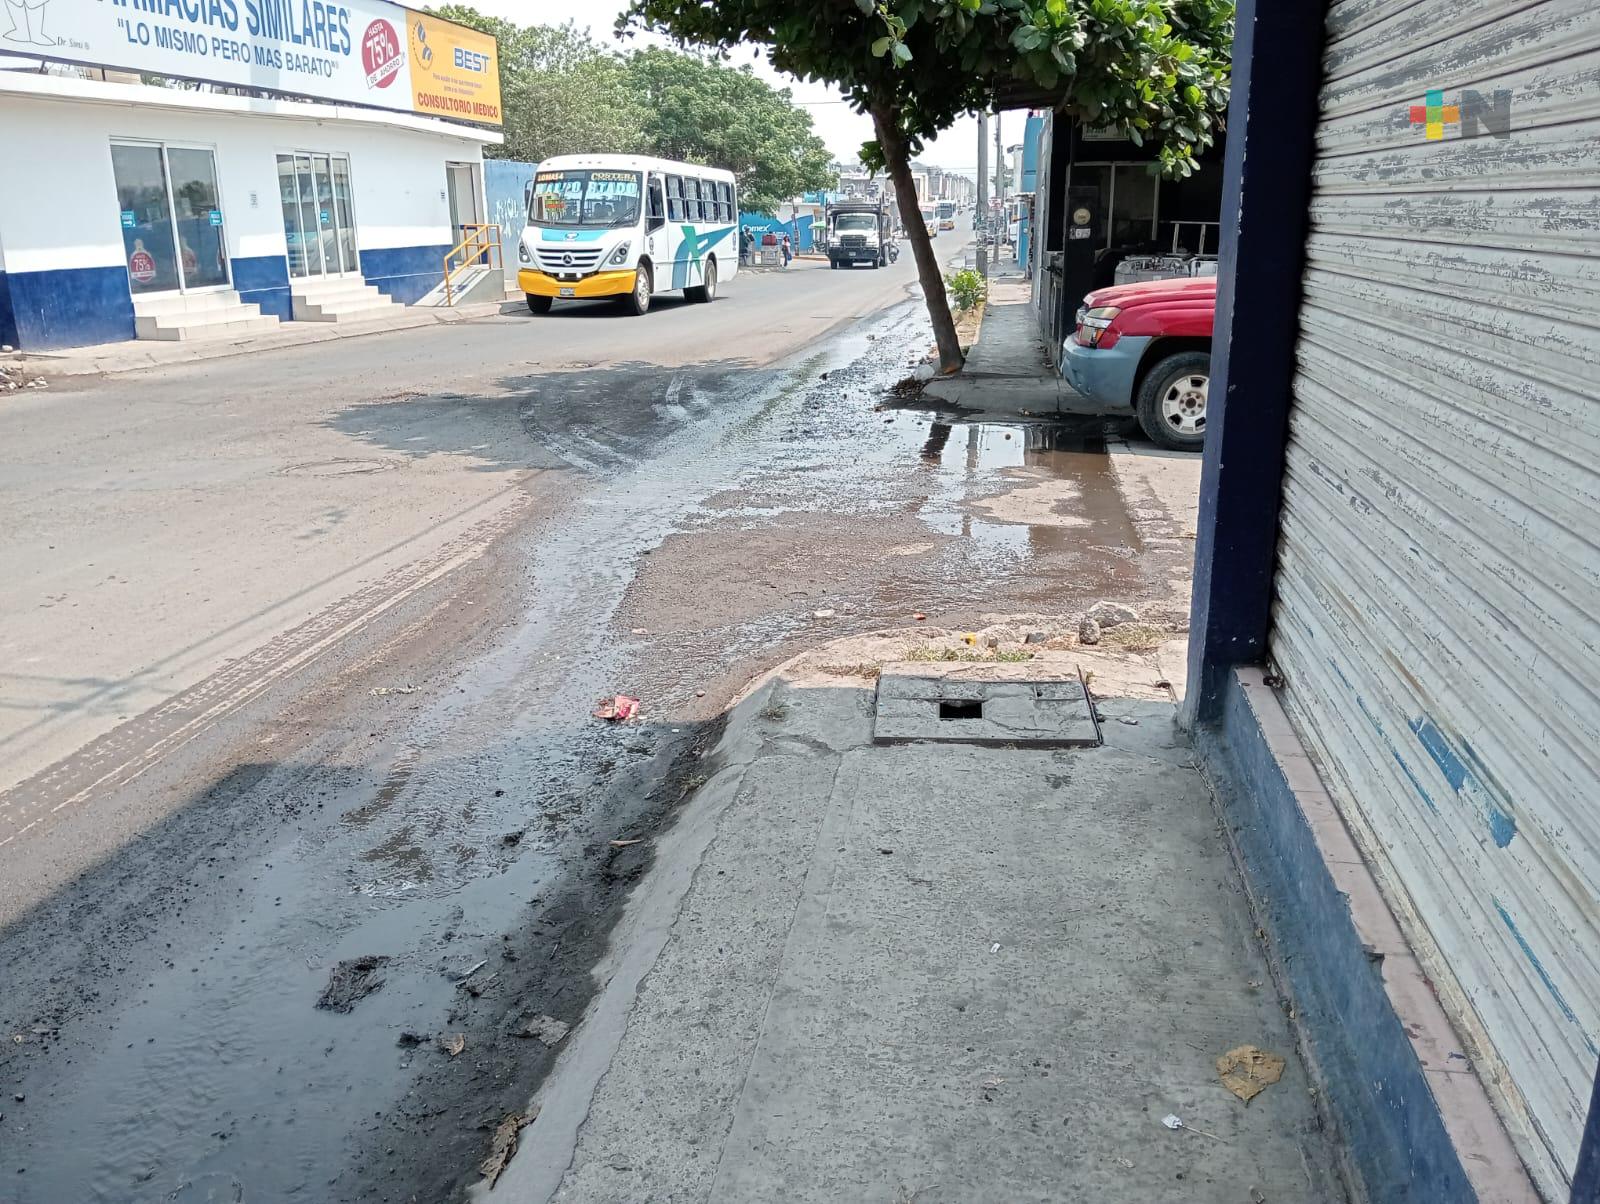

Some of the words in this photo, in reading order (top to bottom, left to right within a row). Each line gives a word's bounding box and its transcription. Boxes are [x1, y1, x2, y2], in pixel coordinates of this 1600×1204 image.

[245, 0, 351, 56] SIMILARES
[368, 22, 384, 37] HASTA
[154, 25, 208, 55] MISMO
[211, 36, 251, 63] PERO
[254, 45, 283, 69] MAS
[366, 30, 394, 69] 75%
[454, 47, 489, 74] BEST
[380, 58, 400, 77] AHORRO
[417, 92, 472, 115] CONSULTORIO
[472, 101, 499, 119] MEDICO
